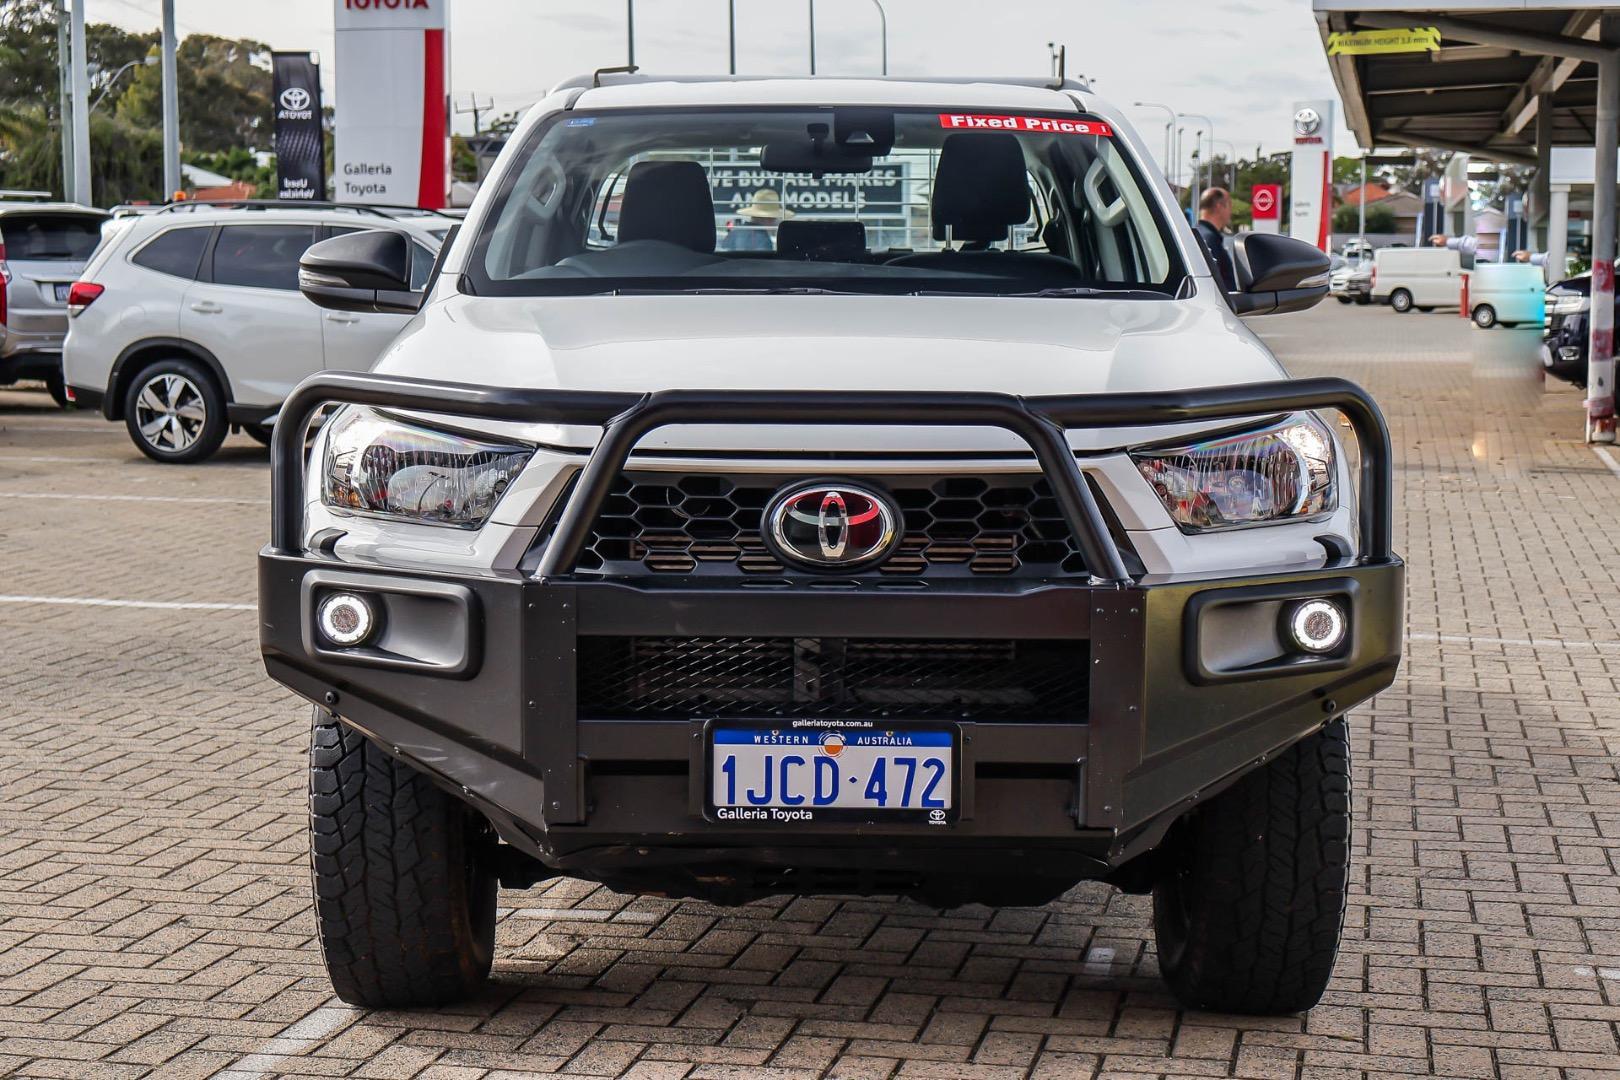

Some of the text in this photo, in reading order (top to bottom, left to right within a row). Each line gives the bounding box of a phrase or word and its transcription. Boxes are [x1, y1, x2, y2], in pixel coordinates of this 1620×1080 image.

[951, 115, 1017, 129] Fixed
[1024, 118, 1090, 133] Price
[343, 162, 393, 175] Galleria
[738, 170, 777, 187] BUY
[785, 171, 819, 187] ALL
[825, 170, 896, 187] MAKES
[344, 182, 387, 196] Toyota
[784, 192, 867, 208] MODELS
[792, 719, 873, 728] galleriatoyota.com.au
[754, 735, 912, 746] WESTERN AUSTRALIA
[717, 808, 813, 822] Galleria Toyota
